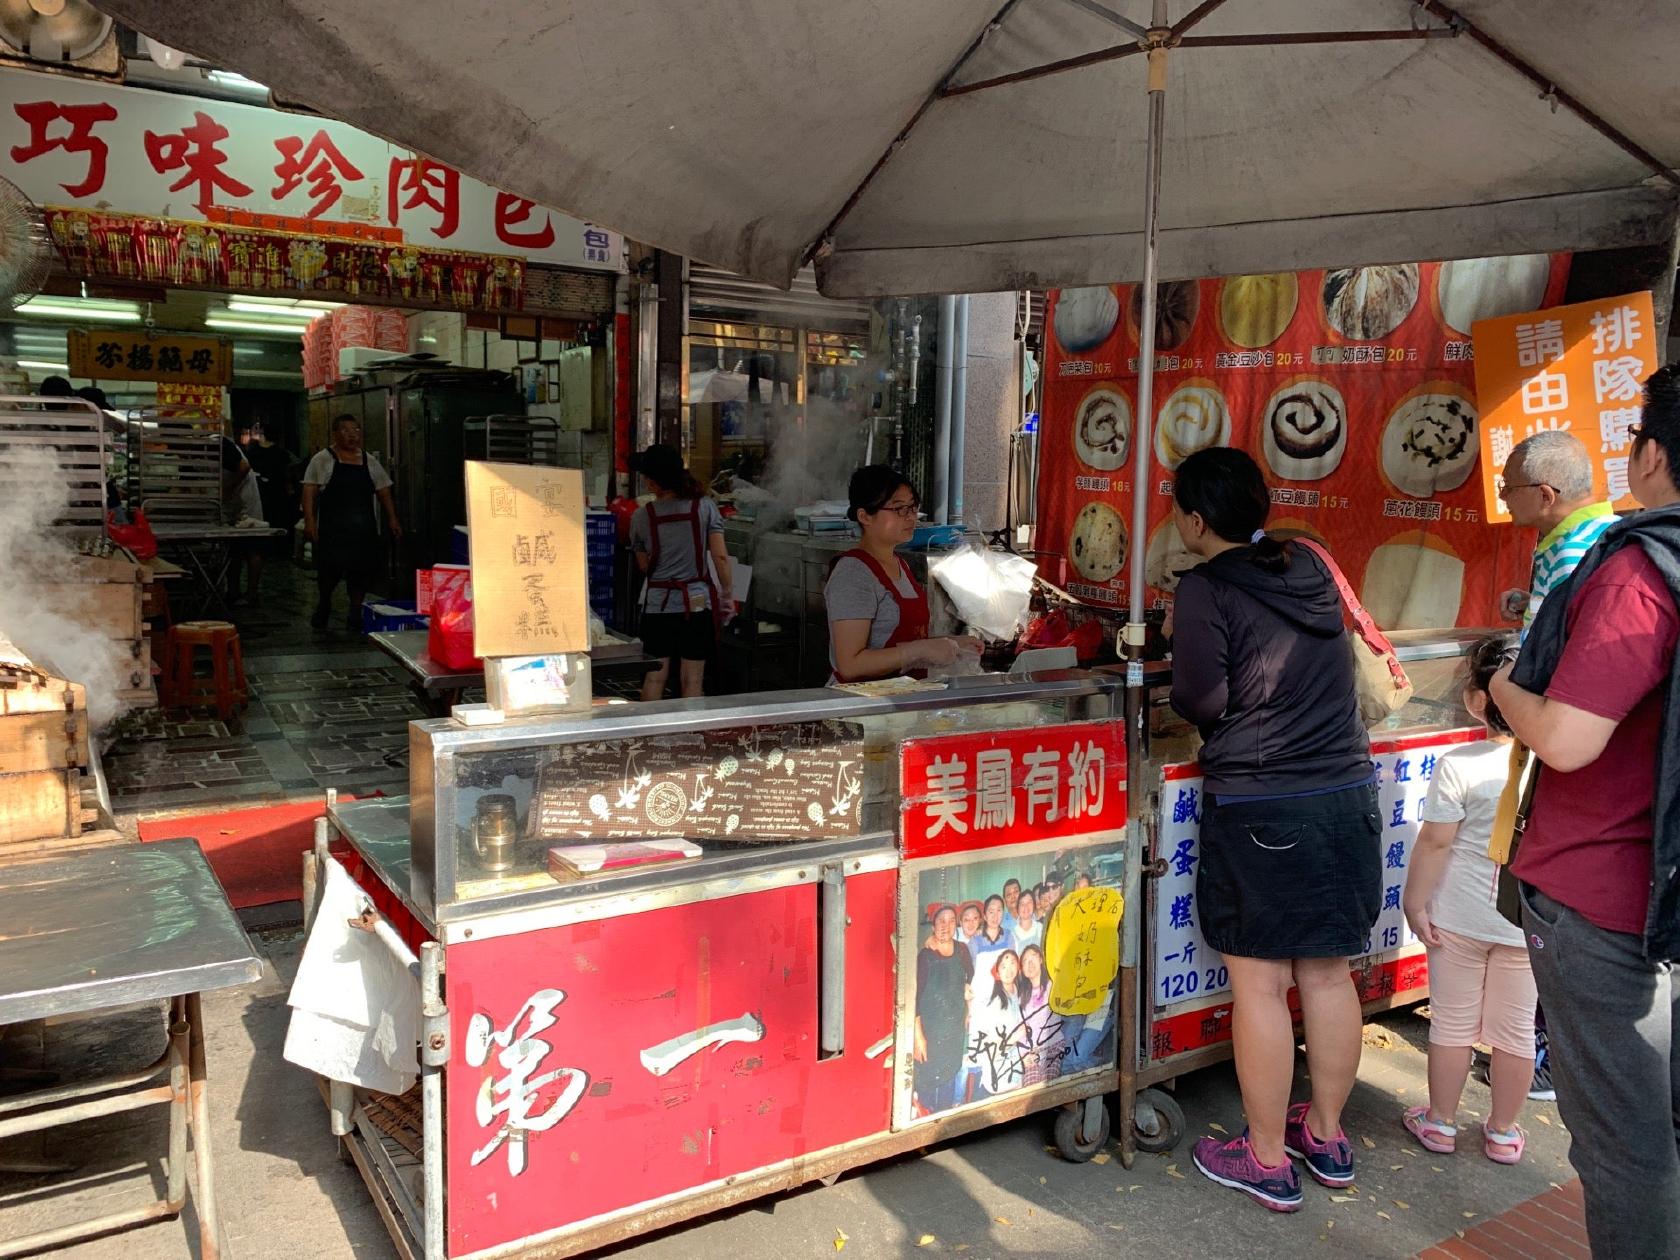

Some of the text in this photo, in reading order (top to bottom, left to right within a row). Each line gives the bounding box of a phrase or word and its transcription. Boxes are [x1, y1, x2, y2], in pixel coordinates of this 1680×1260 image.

[10, 101, 556, 248] 巧味珍肉包
[584, 229, 609, 248] 包
[925, 739, 1106, 840] 美鳳有約
[1169, 787, 1201, 931] 鹹蛋糕
[1381, 757, 1412, 912] 紅豆饅頭
[1164, 942, 1198, 966] 一斤
[1381, 926, 1399, 948] 15
[1161, 970, 1199, 998] 120
[1205, 965, 1229, 991] 20
[466, 988, 767, 1177] 第一
